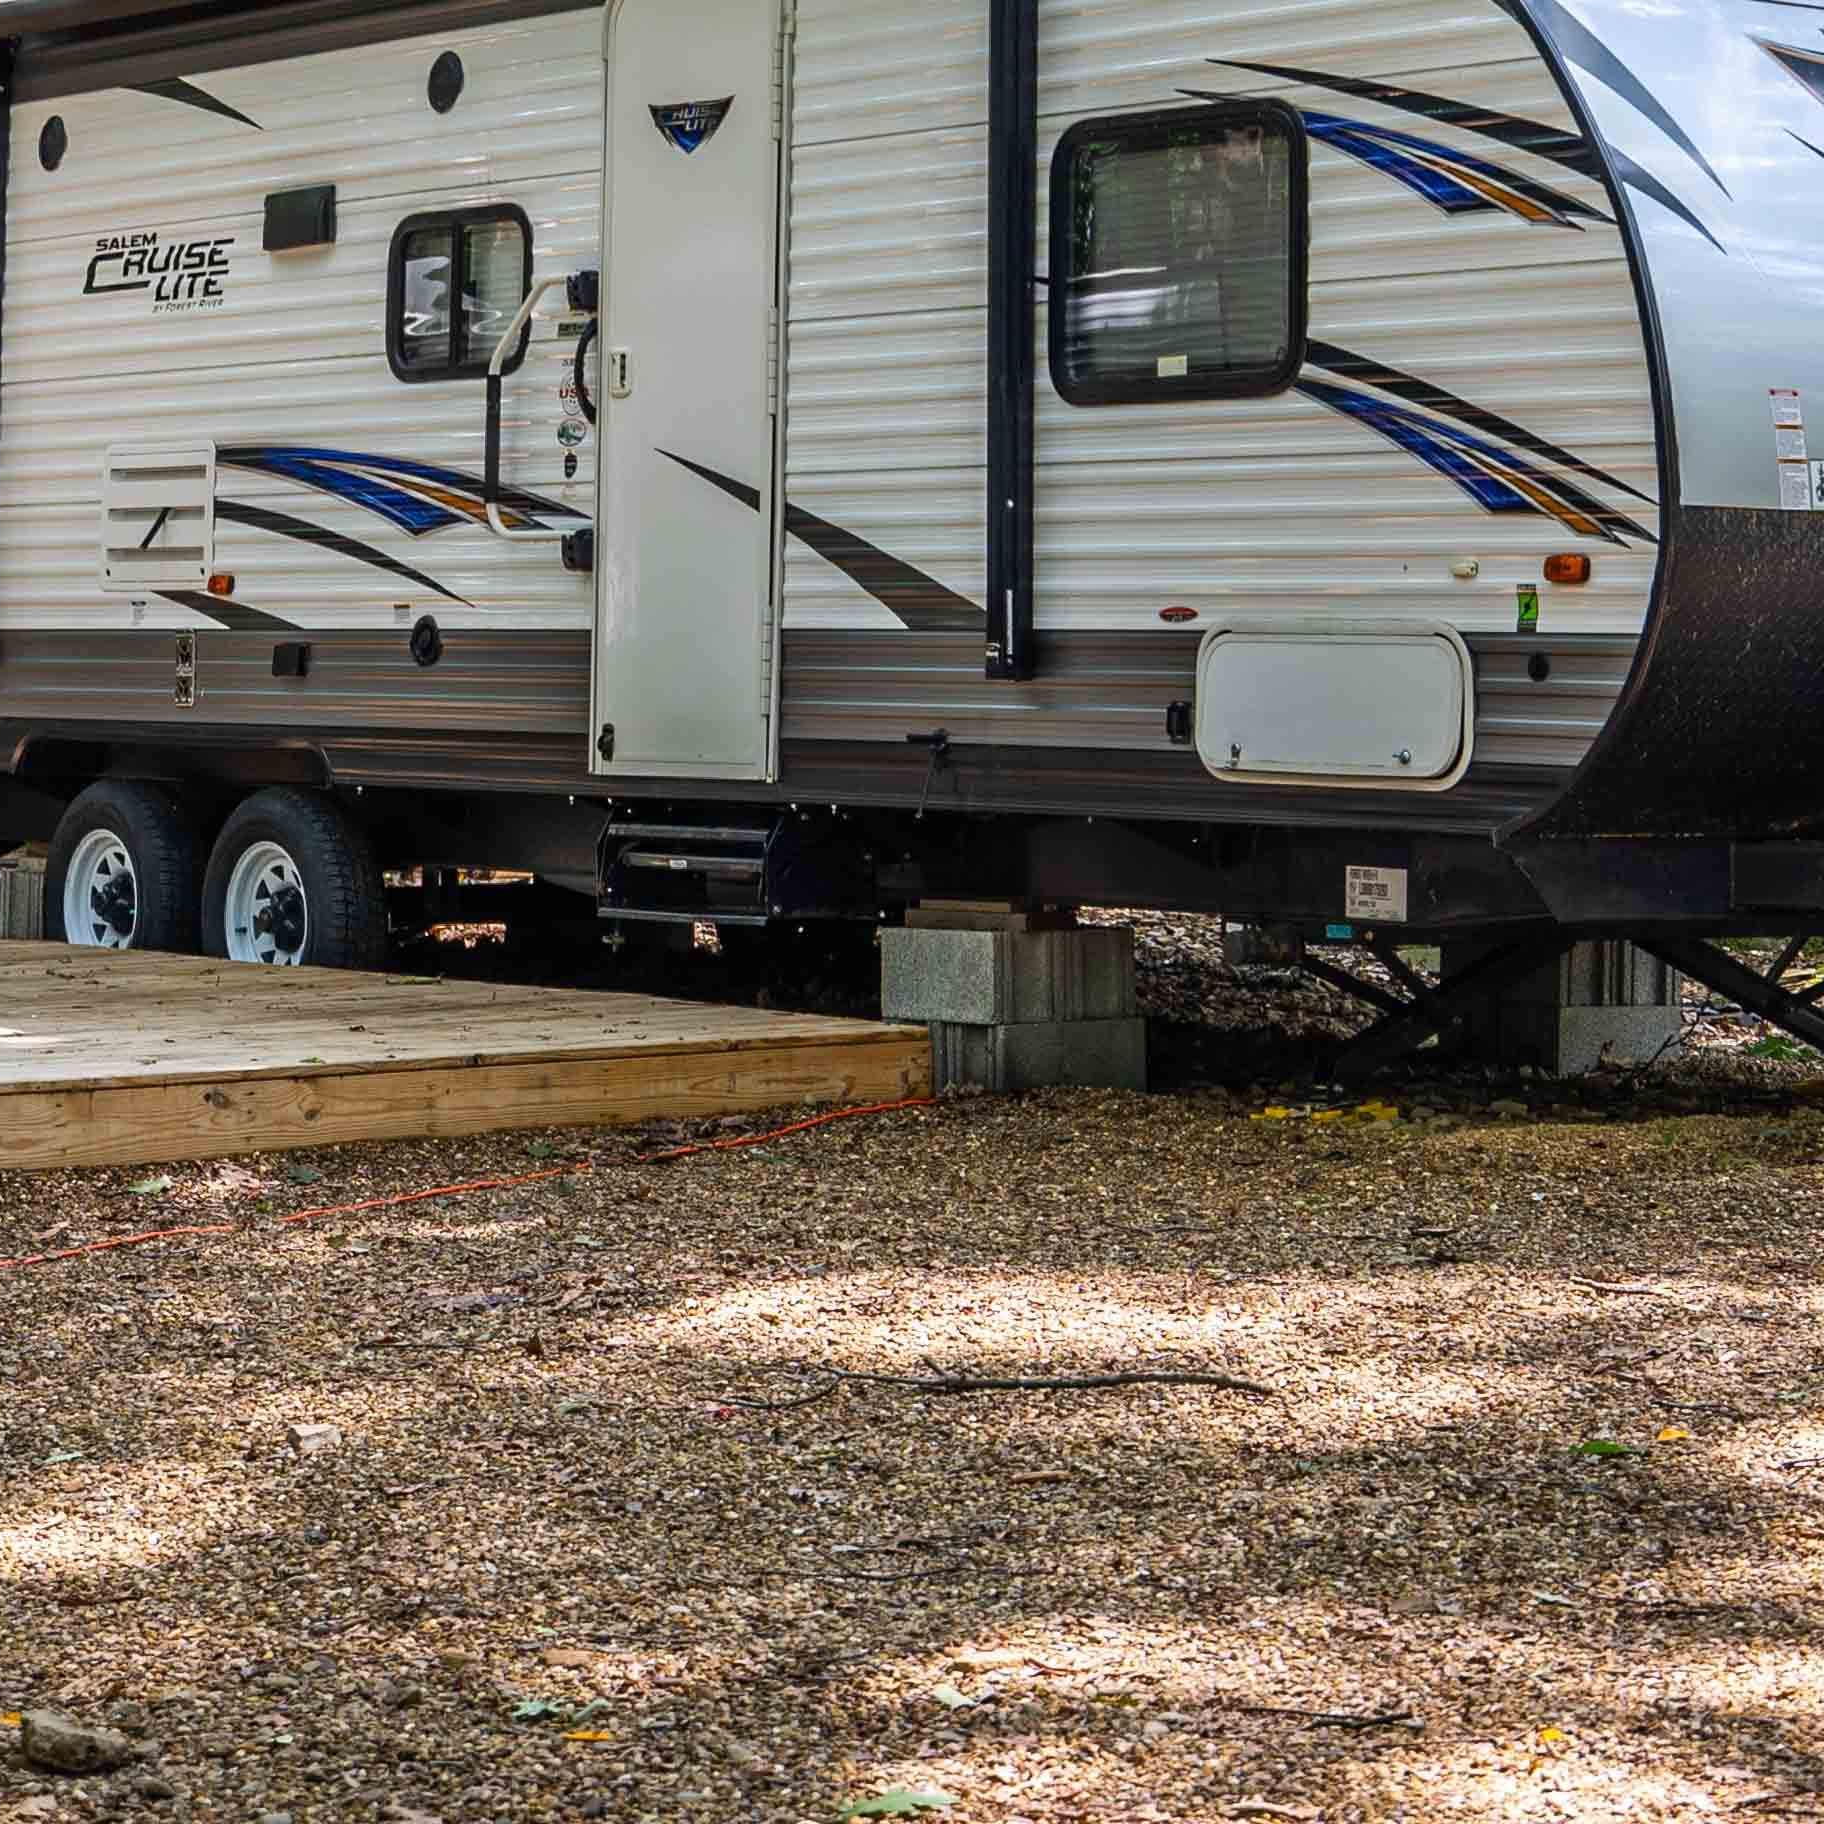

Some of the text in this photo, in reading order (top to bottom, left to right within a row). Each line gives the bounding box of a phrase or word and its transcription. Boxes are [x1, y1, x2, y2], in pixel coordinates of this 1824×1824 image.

[96, 232, 158, 252] SALEM
[83, 238, 235, 294] CRUISE
[155, 269, 229, 301] LITE
